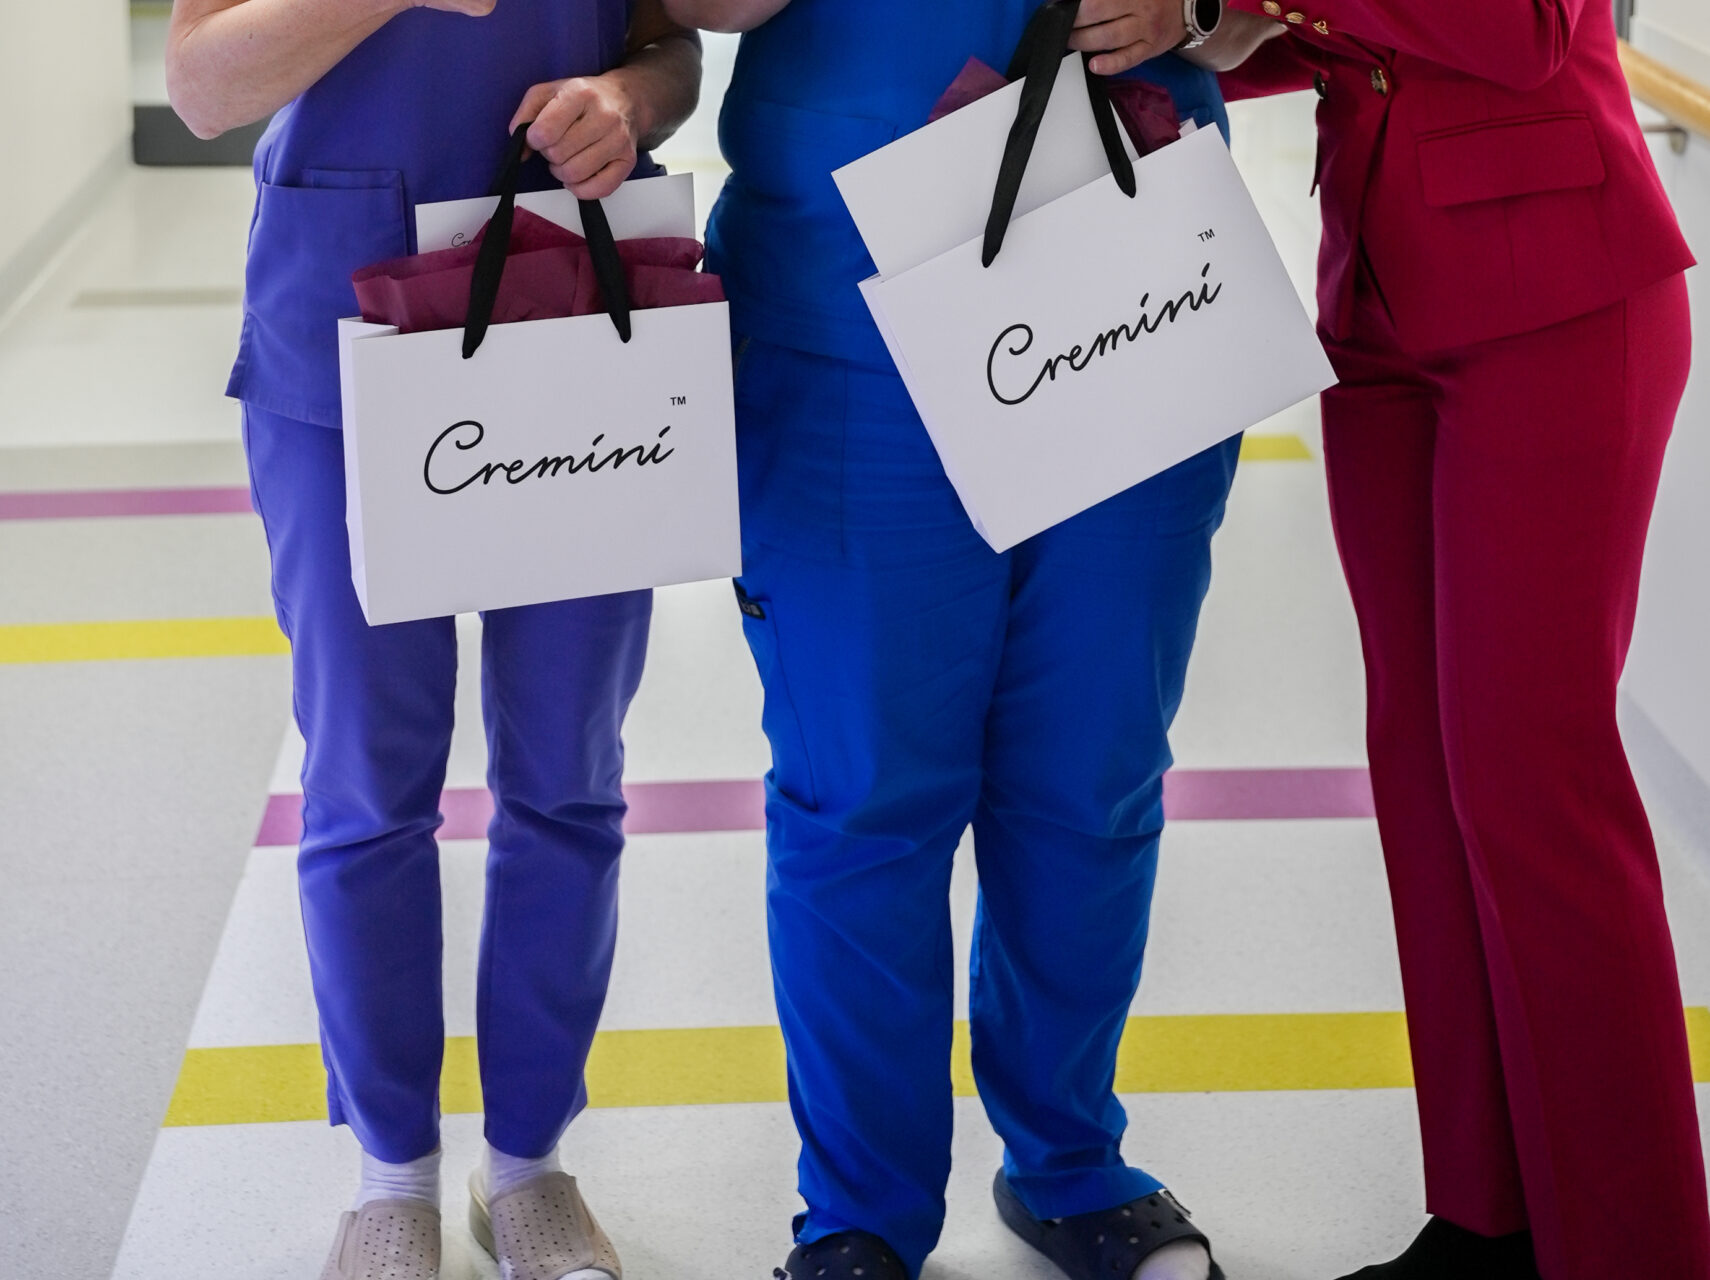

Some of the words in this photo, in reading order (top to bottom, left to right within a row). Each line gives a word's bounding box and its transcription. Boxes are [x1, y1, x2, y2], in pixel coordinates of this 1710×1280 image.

[1197, 229, 1216, 243] TM
[987, 263, 1222, 406] Cremini
[670, 396, 687, 406] TM
[424, 420, 675, 495] Cremini
